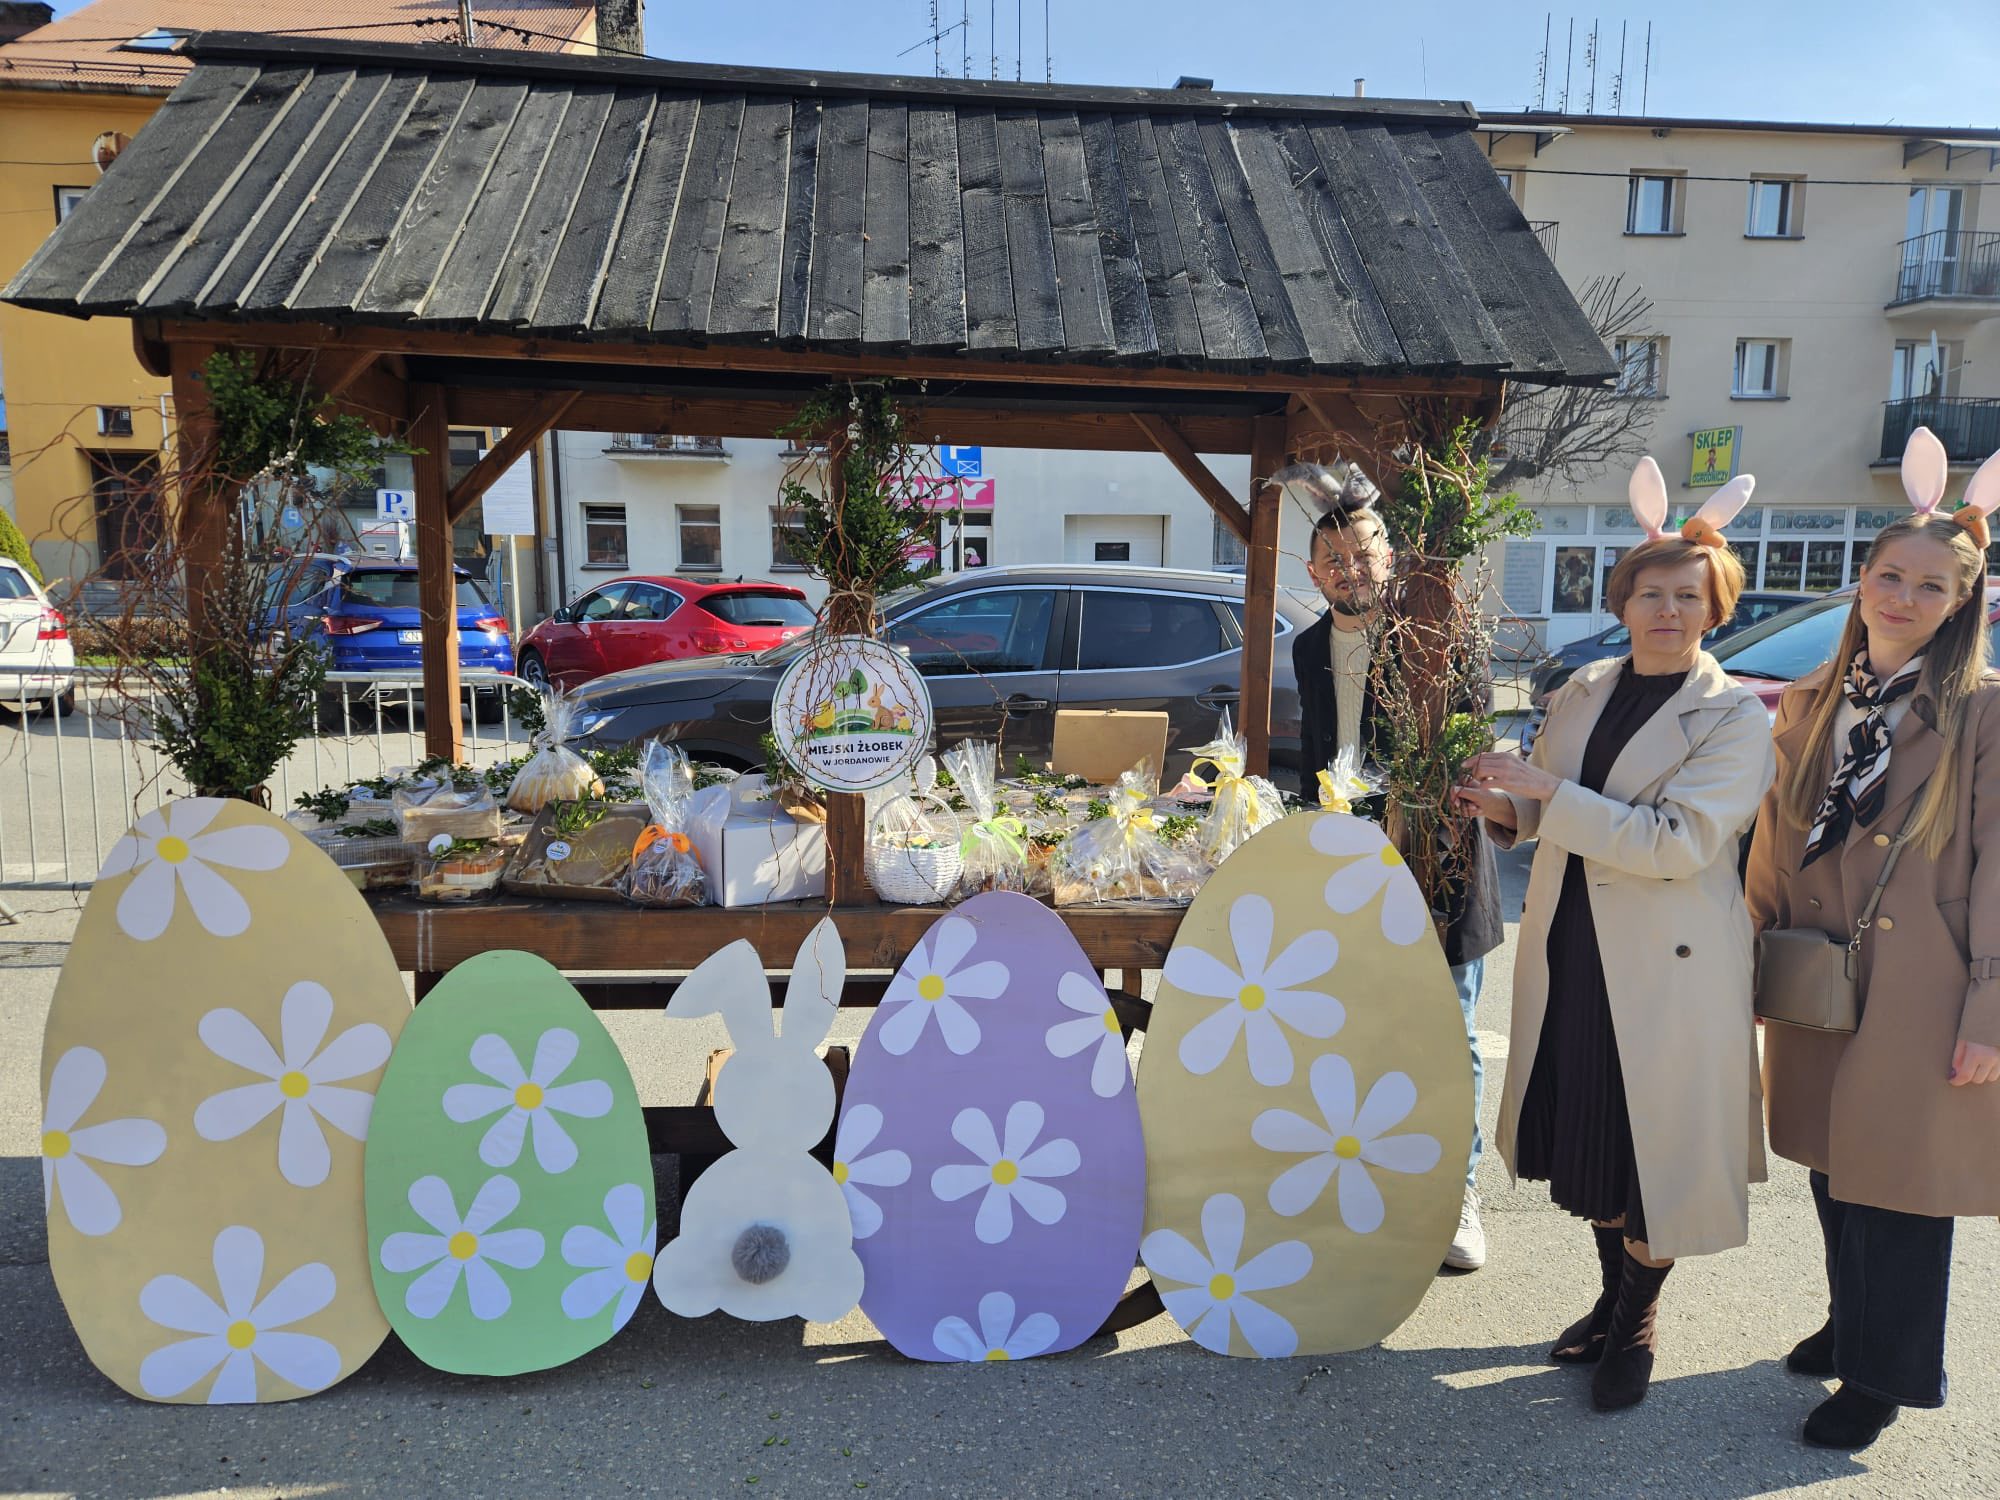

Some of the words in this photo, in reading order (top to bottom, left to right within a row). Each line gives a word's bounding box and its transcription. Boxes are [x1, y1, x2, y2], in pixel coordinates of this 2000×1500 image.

[1696, 430, 1732, 449] SKLEP
[877, 482, 988, 500] ODY
[384, 492, 403, 513] P
[1854, 511, 1905, 529] Rol
[808, 744, 854, 755] MIEJSKI
[857, 740, 903, 752] ŻŁOBEK
[834, 756, 890, 766] JORDANOWIE
